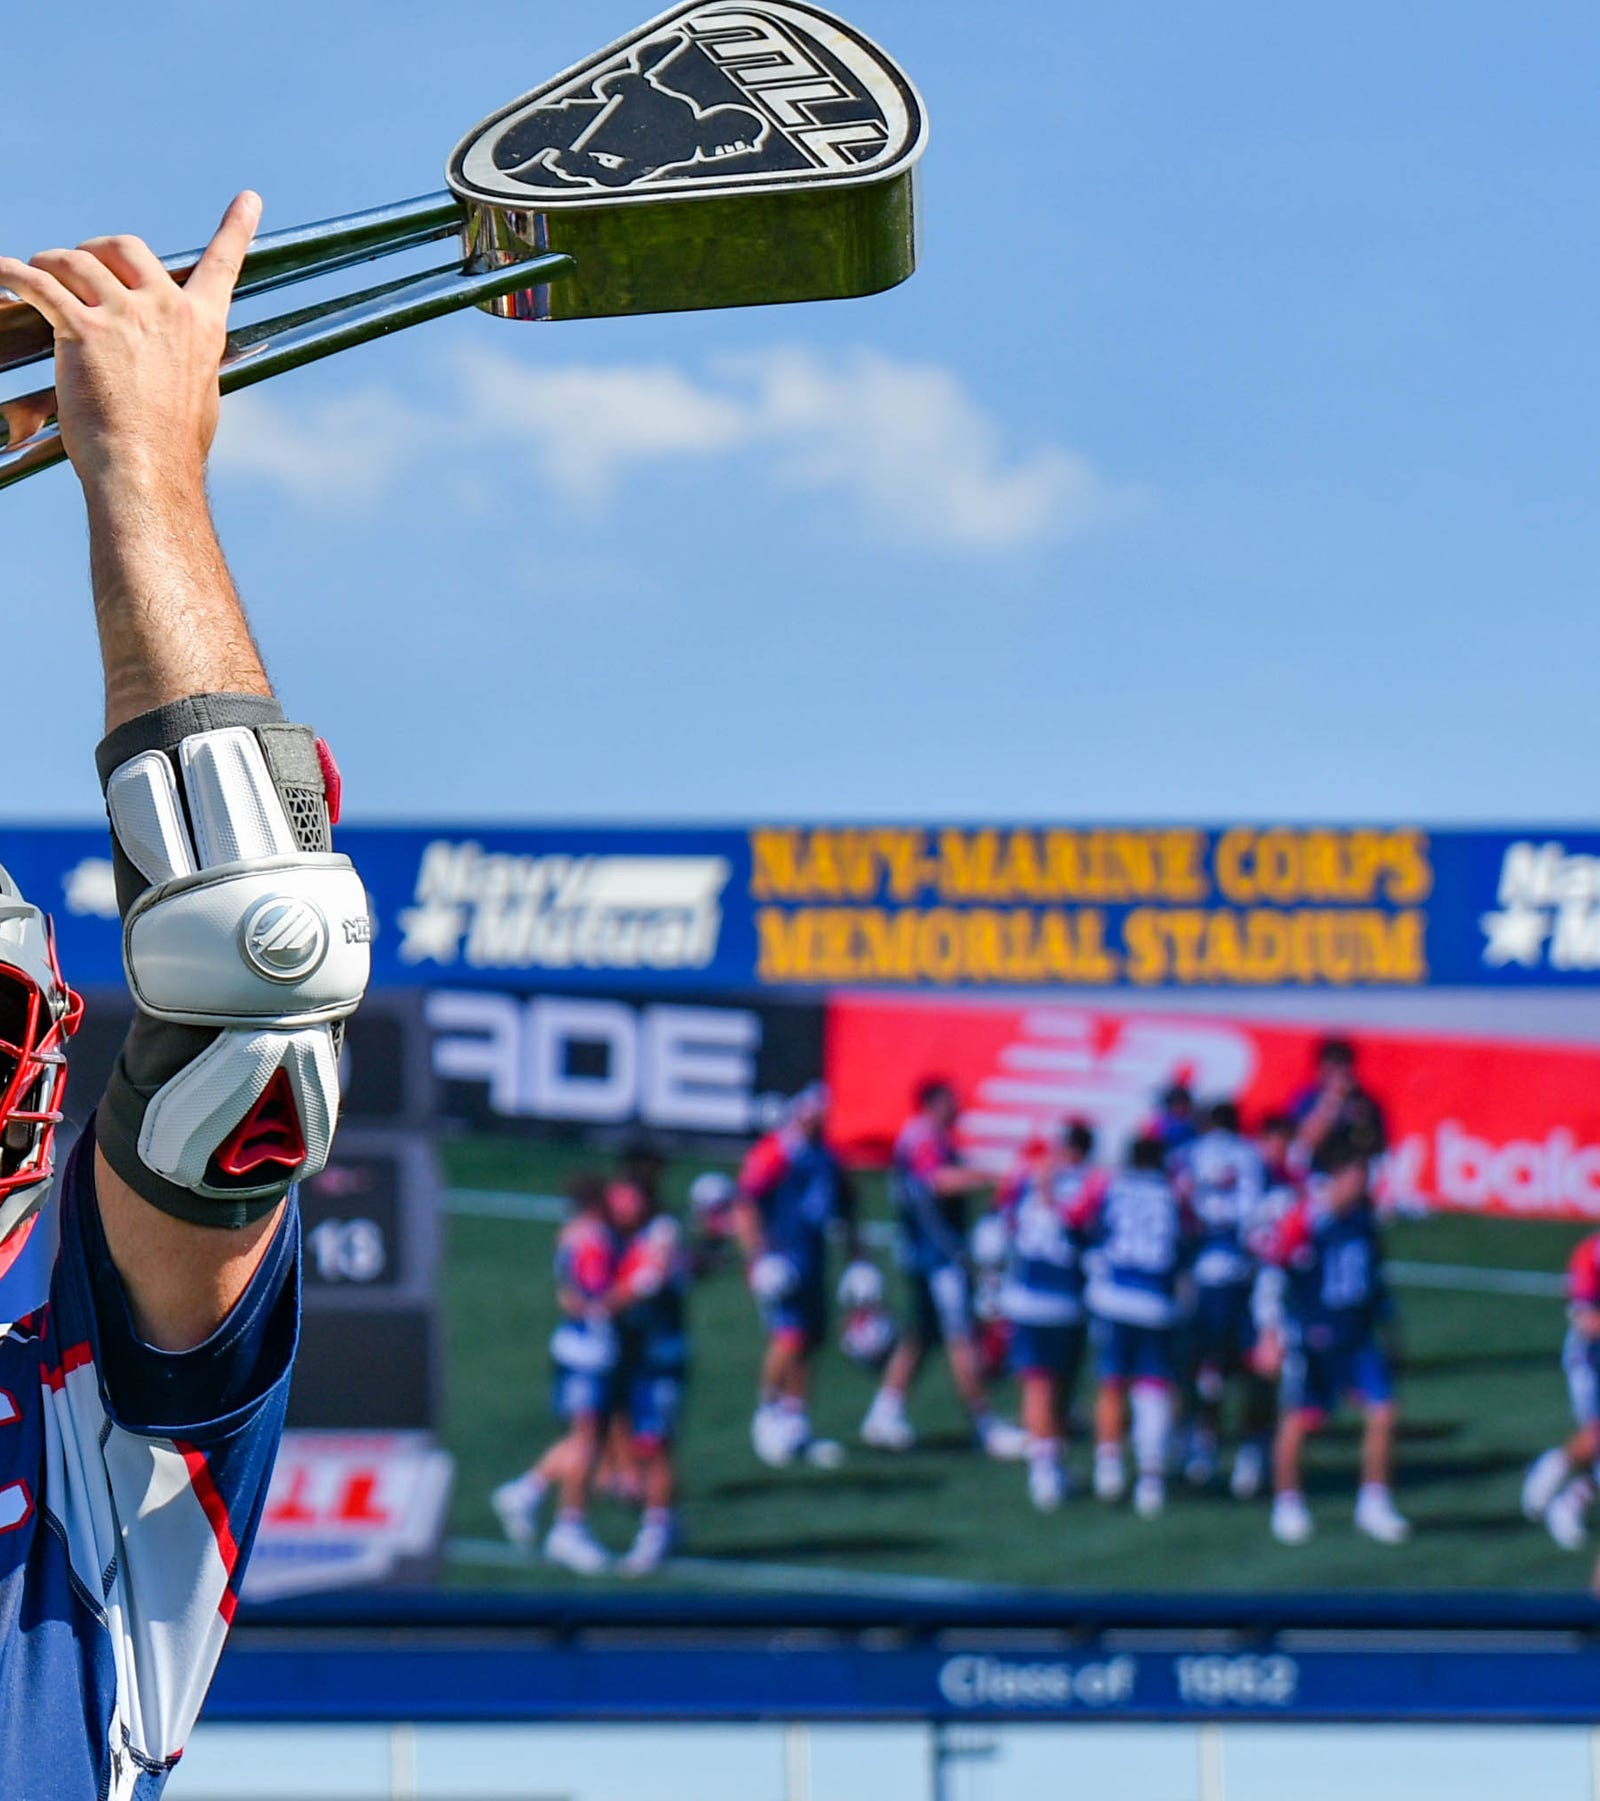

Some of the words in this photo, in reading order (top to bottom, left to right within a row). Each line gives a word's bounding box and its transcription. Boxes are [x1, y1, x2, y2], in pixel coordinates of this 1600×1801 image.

[686, 12, 884, 168] MLL
[414, 841, 596, 904] Navy
[752, 829, 1210, 900] NAVY-MARINE
[1215, 827, 1434, 903] CORPS
[465, 900, 722, 969] Mutual
[756, 905, 1118, 984] MEMORIAL
[1125, 905, 1429, 984] STADIUM
[309, 1218, 385, 1282] 13
[938, 1654, 1071, 1704] Class
[1073, 1654, 1136, 1705] of
